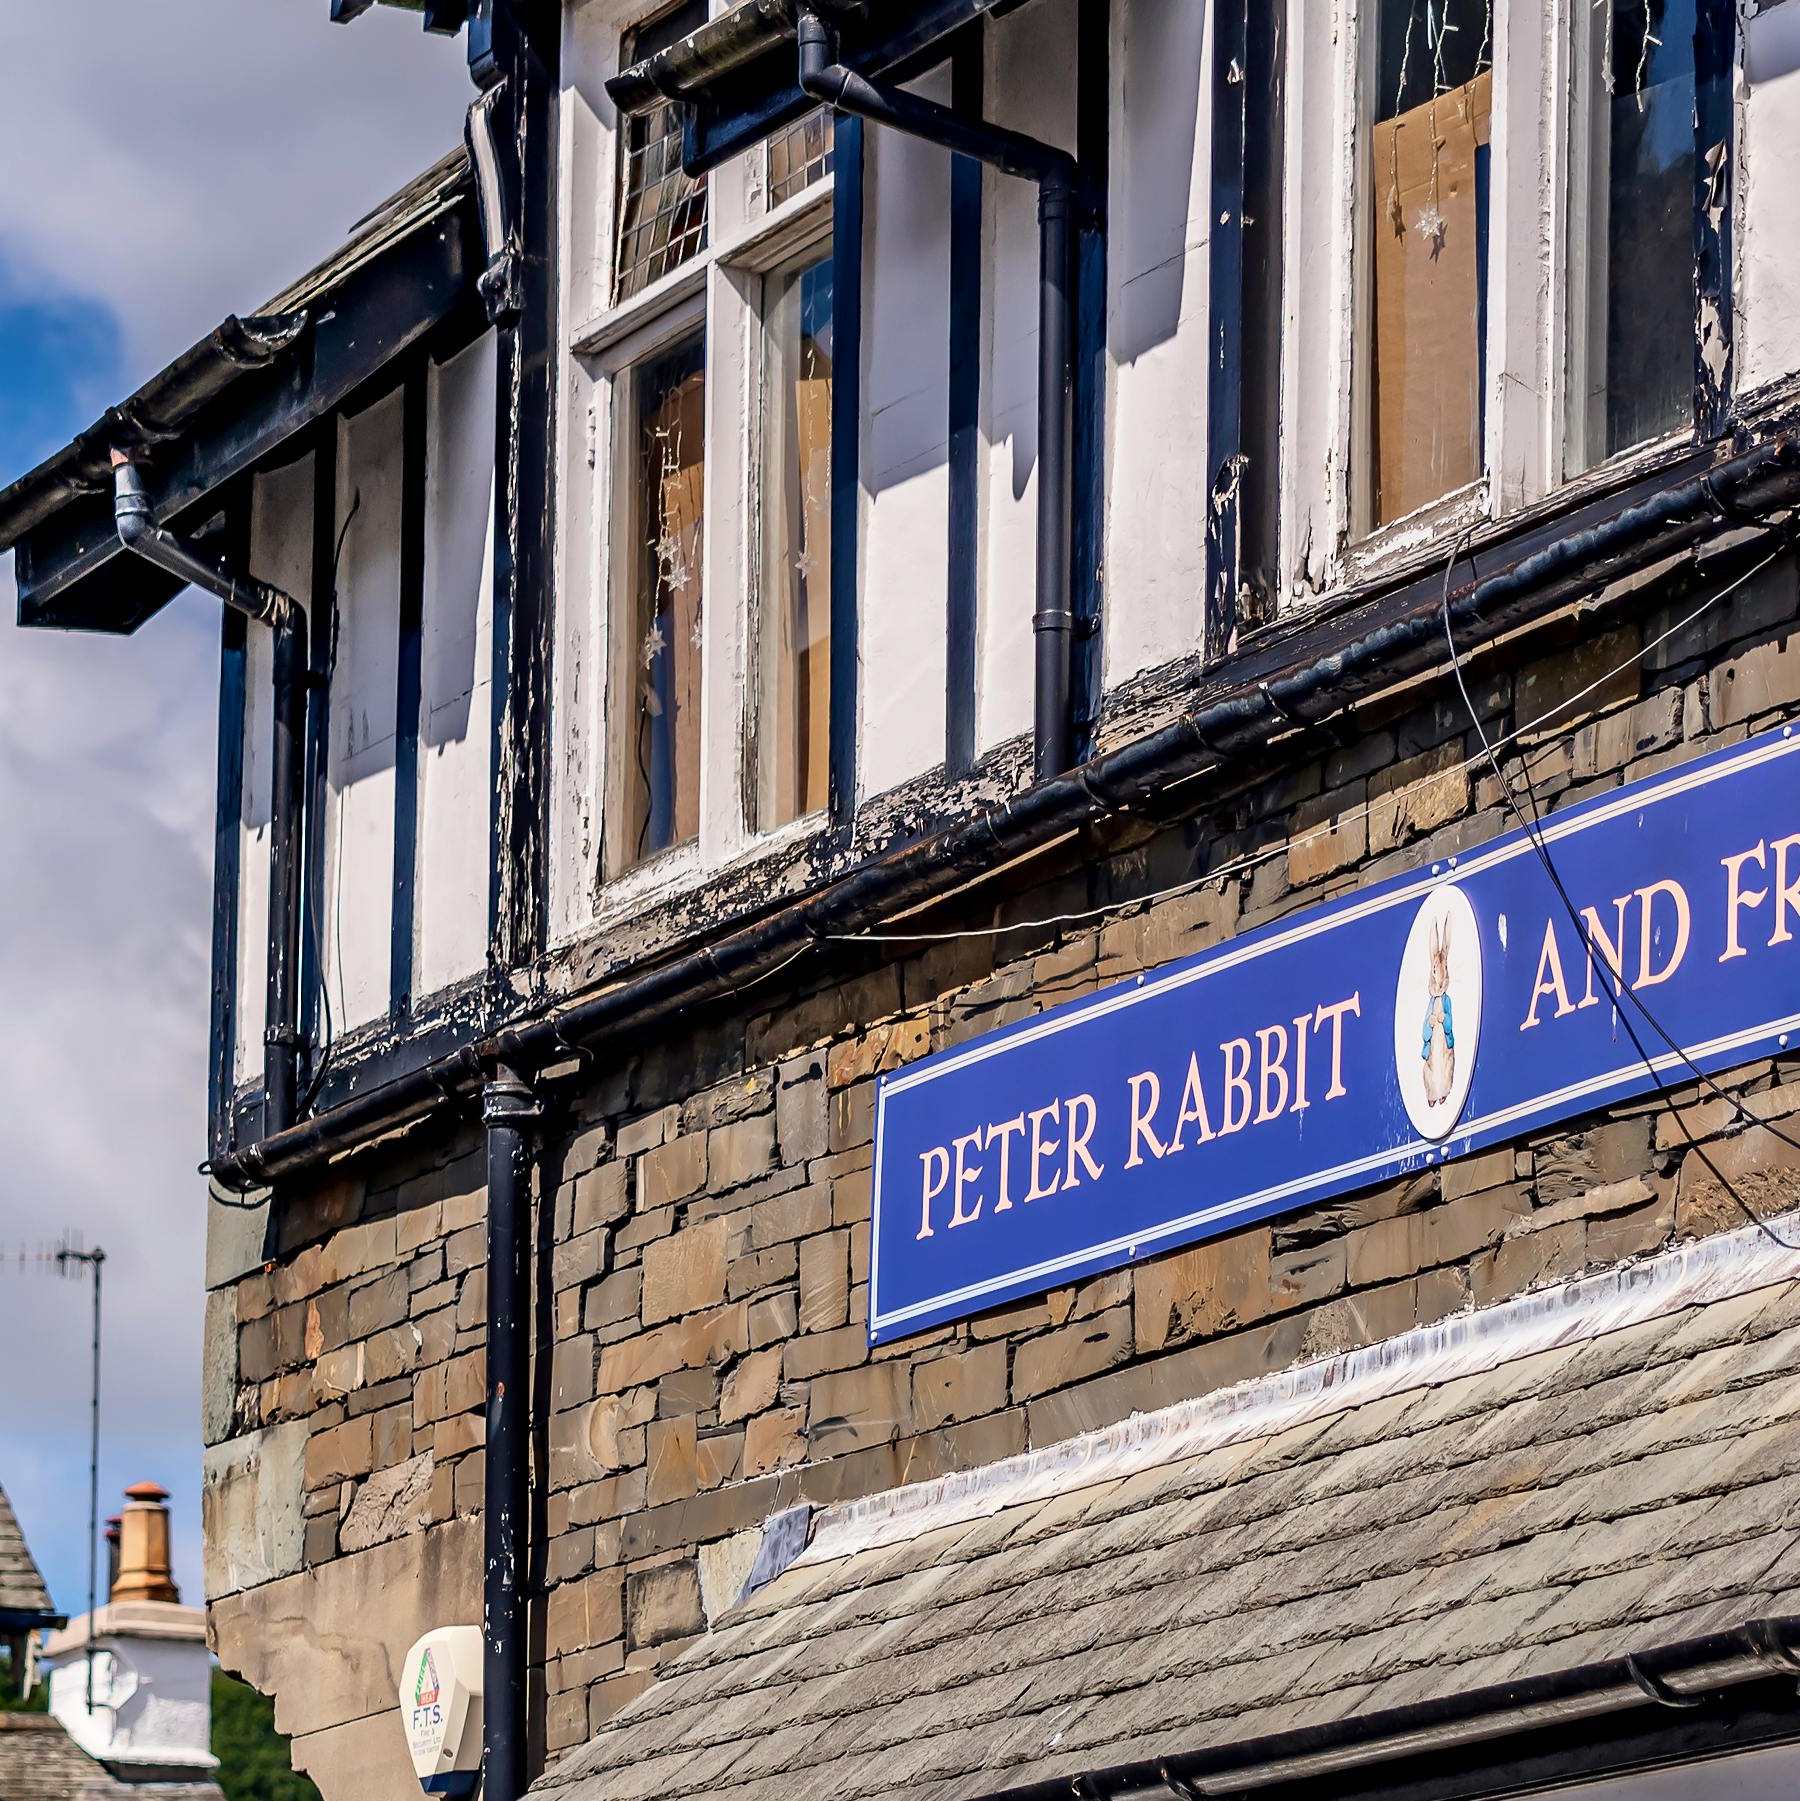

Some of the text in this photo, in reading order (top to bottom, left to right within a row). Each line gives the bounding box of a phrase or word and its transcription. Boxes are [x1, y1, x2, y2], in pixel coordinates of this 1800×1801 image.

[915, 1093, 1105, 1241] PETER
[1122, 989, 1362, 1170] RABBIT
[1518, 878, 1692, 1032] AND
